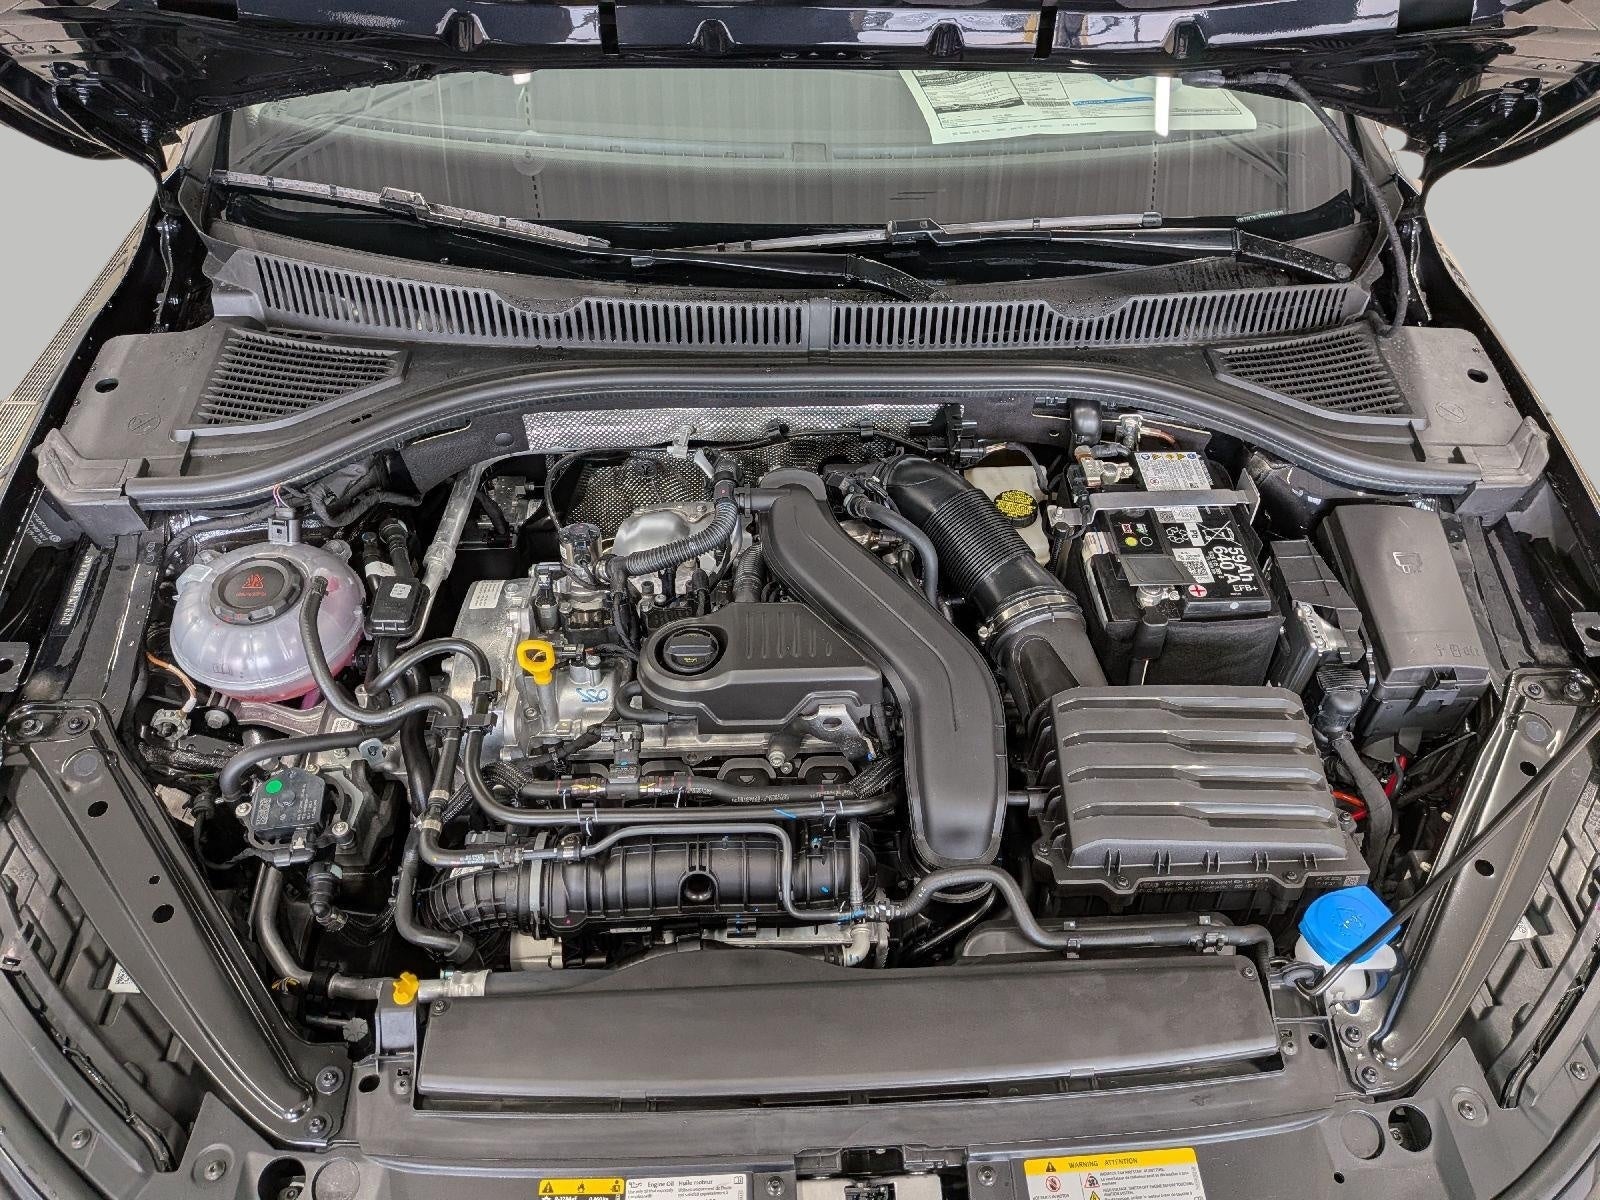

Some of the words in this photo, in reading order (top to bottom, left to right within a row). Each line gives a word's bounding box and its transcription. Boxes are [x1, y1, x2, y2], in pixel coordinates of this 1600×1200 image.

[1212, 545, 1236, 570] 640
[1228, 546, 1255, 582] 59Ah
[1223, 573, 1241, 585] A
[1232, 584, 1259, 592] EFB+
[1068, 1160, 1099, 1169] WARNING
[1104, 1157, 1138, 1167] ATTENTION
